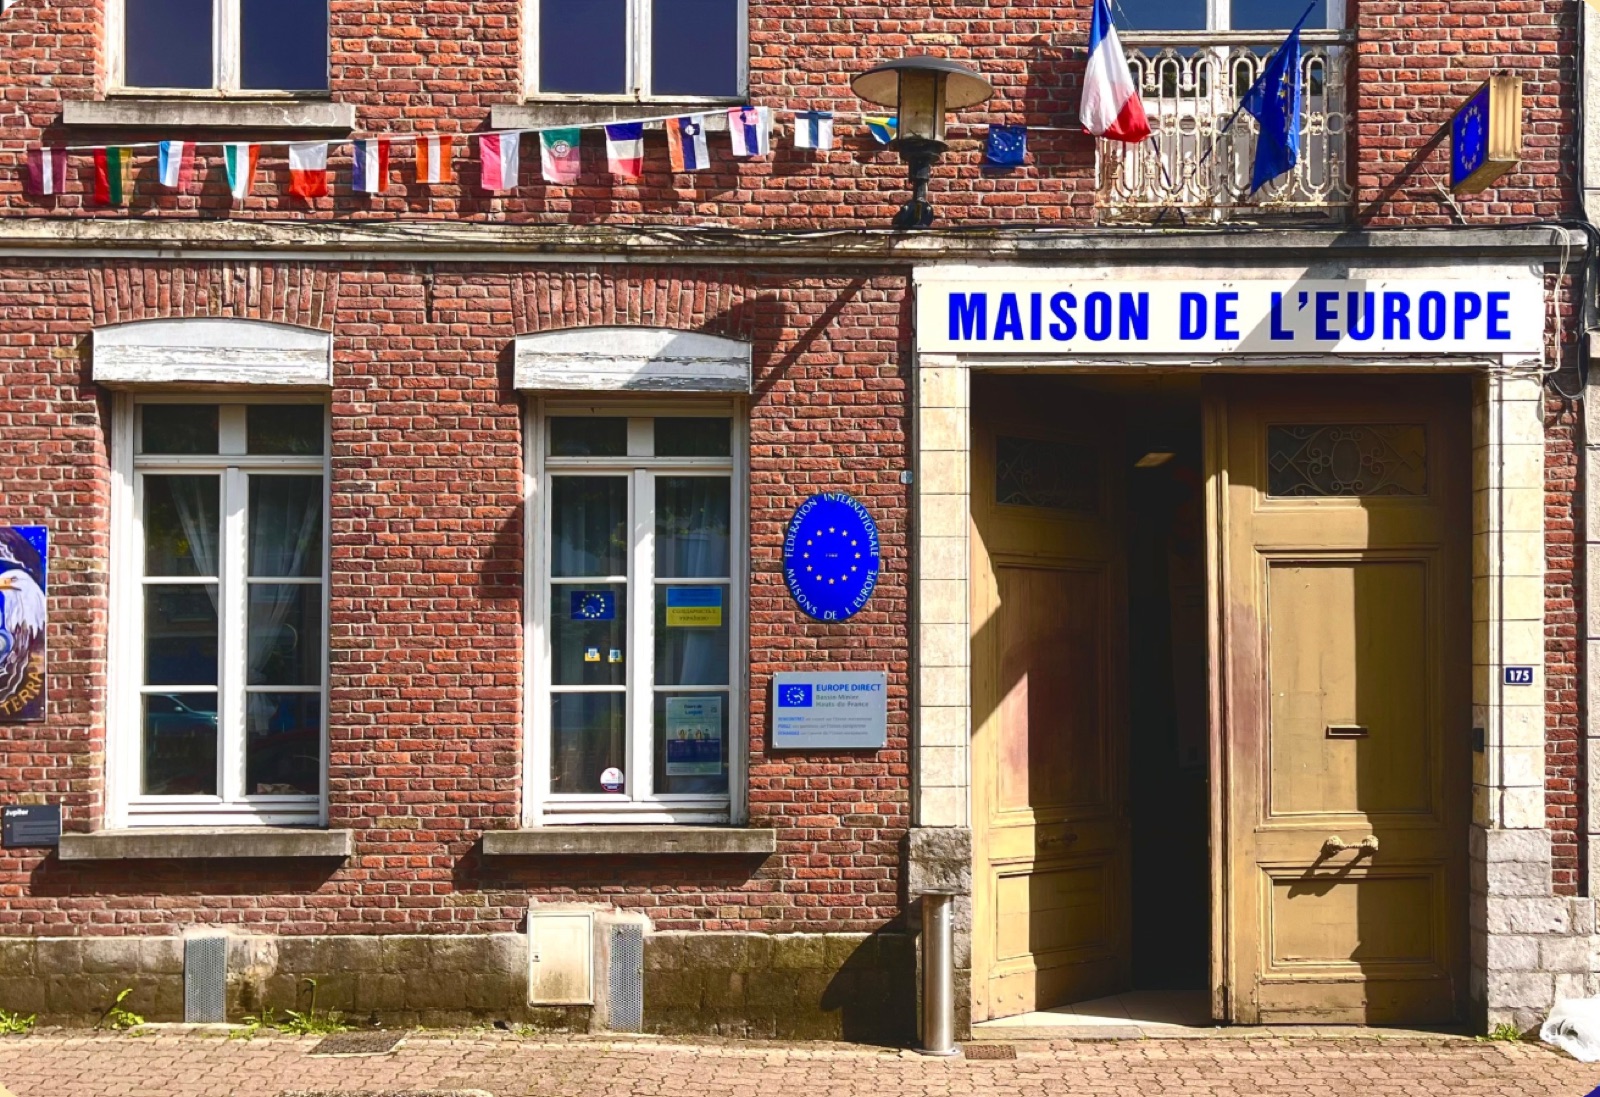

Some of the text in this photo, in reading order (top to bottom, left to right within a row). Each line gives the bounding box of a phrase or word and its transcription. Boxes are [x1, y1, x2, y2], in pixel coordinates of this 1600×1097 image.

[949, 290, 1512, 342] MAISON DE L'EUROPE
[784, 493, 879, 558] FEDERATION INTERNATIONALE
[786, 568, 818, 615] MAISONS
[823, 610, 838, 620] DE
[852, 568, 878, 608] EUROPE
[1509, 669, 1530, 682] 175
